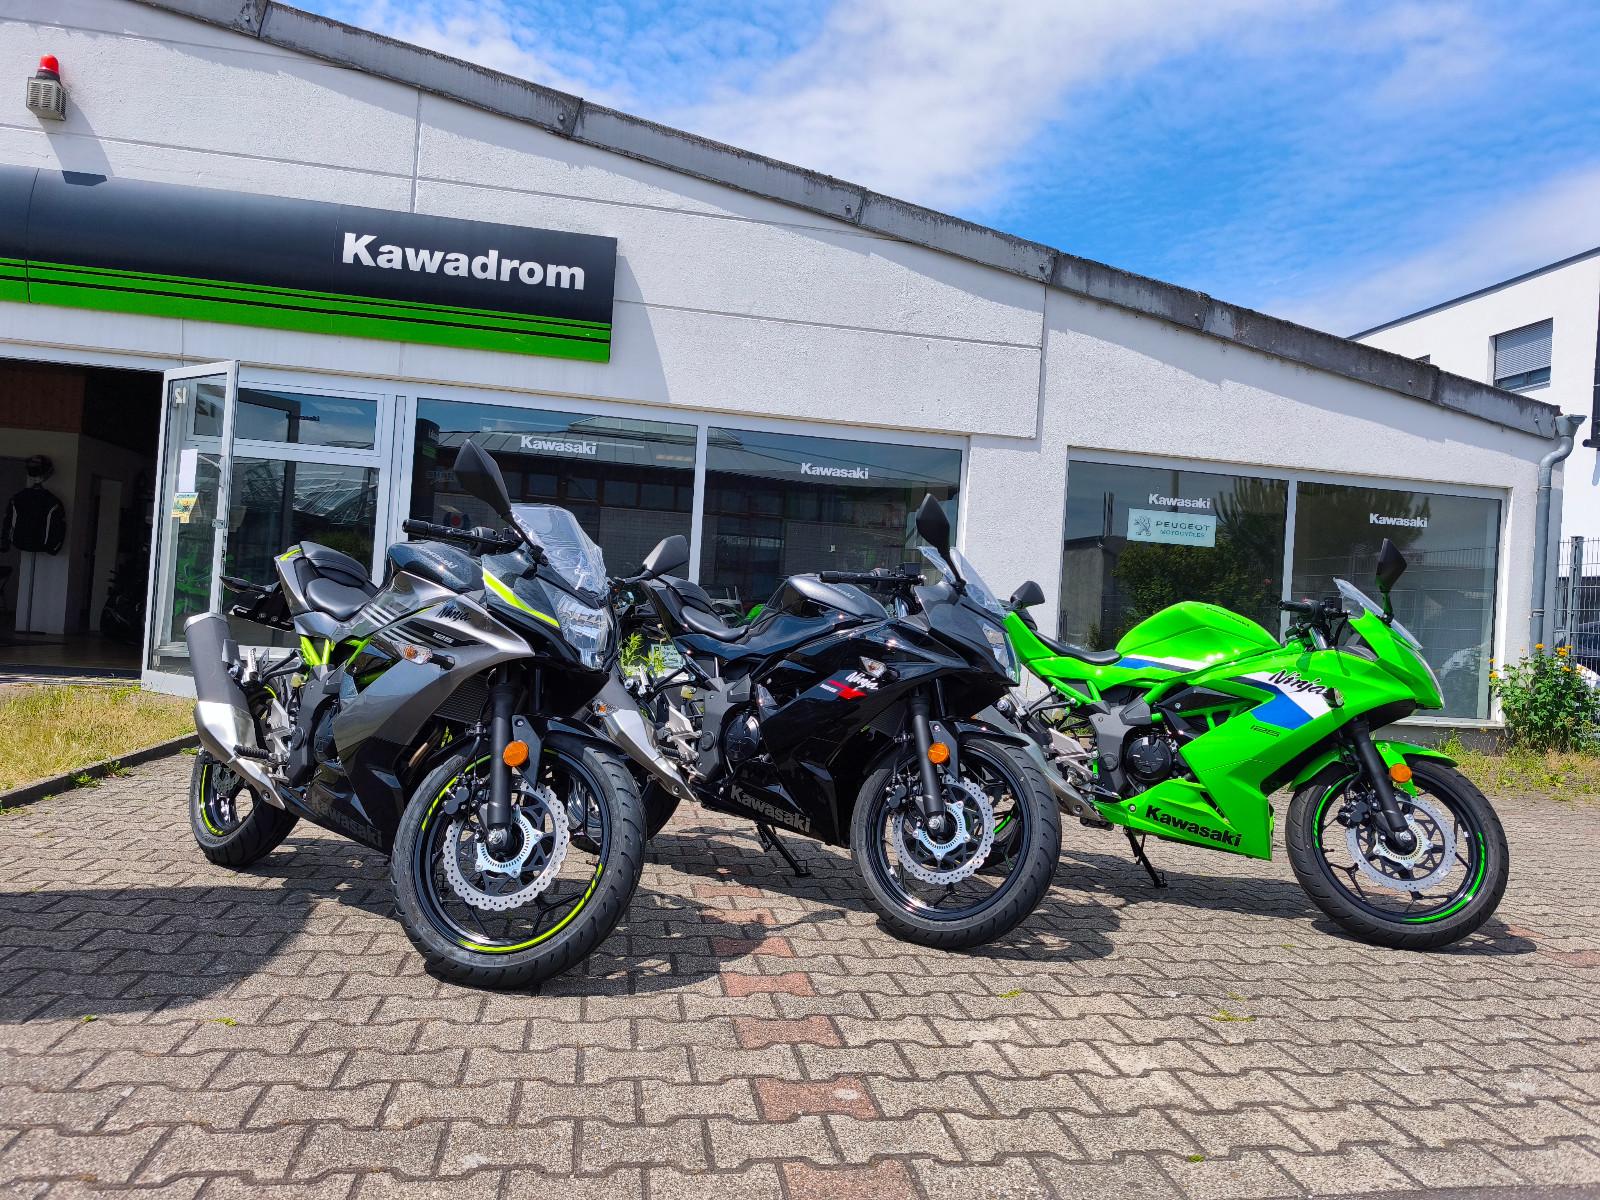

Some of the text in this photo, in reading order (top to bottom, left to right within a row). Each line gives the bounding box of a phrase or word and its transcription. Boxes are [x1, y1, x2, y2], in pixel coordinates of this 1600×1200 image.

[342, 232, 585, 291] Kawadrom
[520, 435, 597, 455] Kawasaki
[800, 462, 869, 480] Kawasaki
[1148, 493, 1211, 509] Kawasaki
[1155, 520, 1211, 531] PEUGEOT
[1369, 512, 1428, 528] Kawasaki
[1268, 669, 1327, 695] Ninja
[311, 789, 383, 848] Kawasaki
[730, 784, 811, 833] Kawasaki
[1145, 804, 1242, 847] Kawasaki
